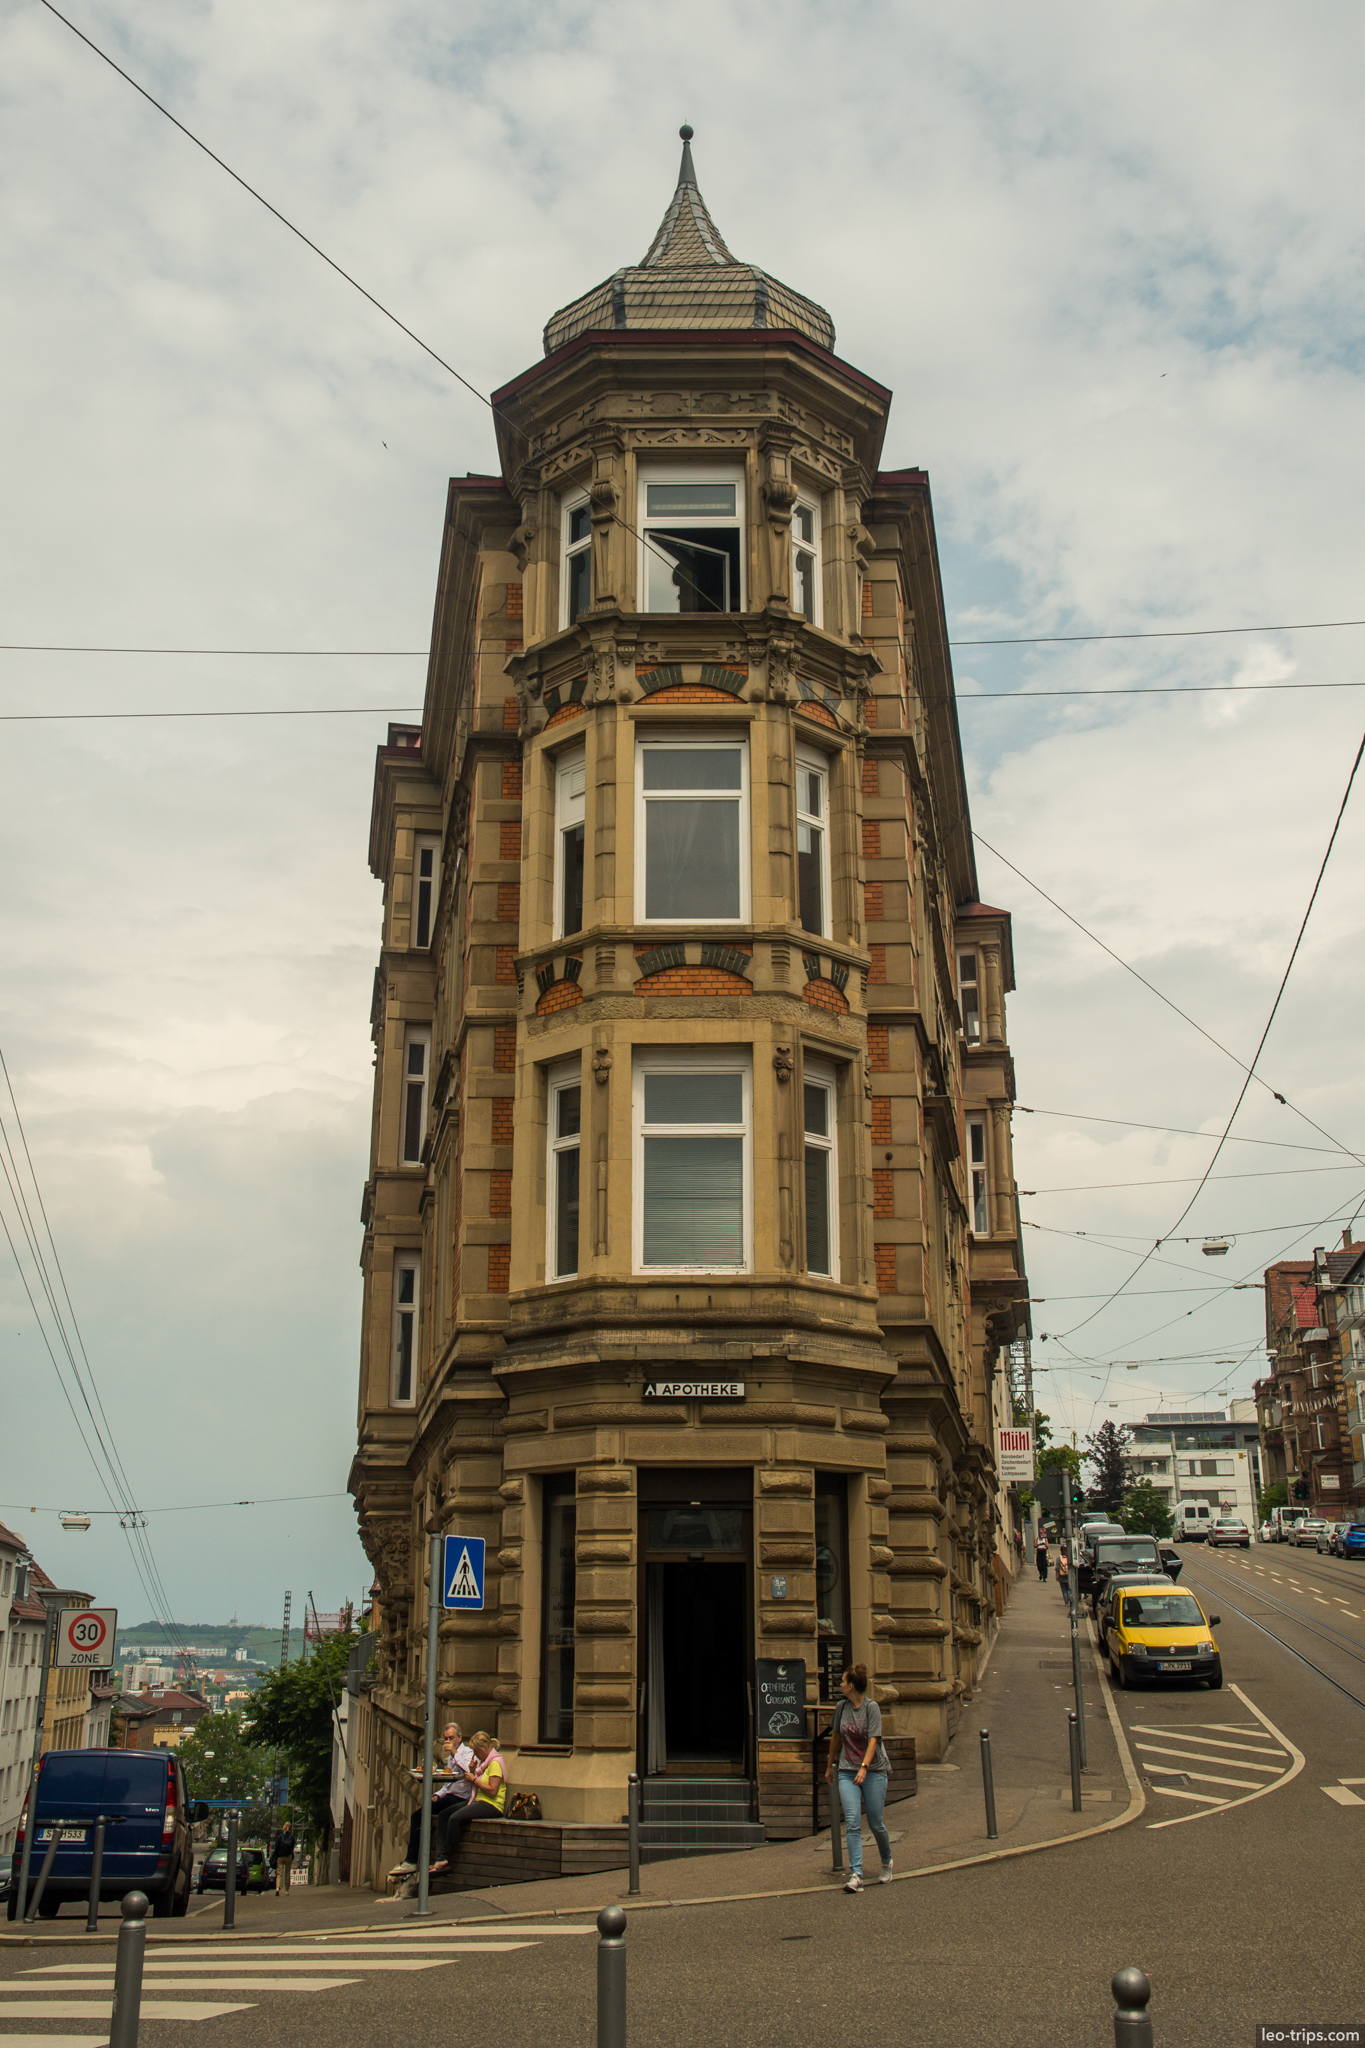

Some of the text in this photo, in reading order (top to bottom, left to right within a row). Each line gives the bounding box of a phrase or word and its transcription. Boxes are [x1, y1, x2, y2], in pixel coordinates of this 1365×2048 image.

[662, 1384, 738, 1395] APOTHEKE
[76, 1624, 98, 1641] 30
[70, 1654, 99, 1664] ZONE
